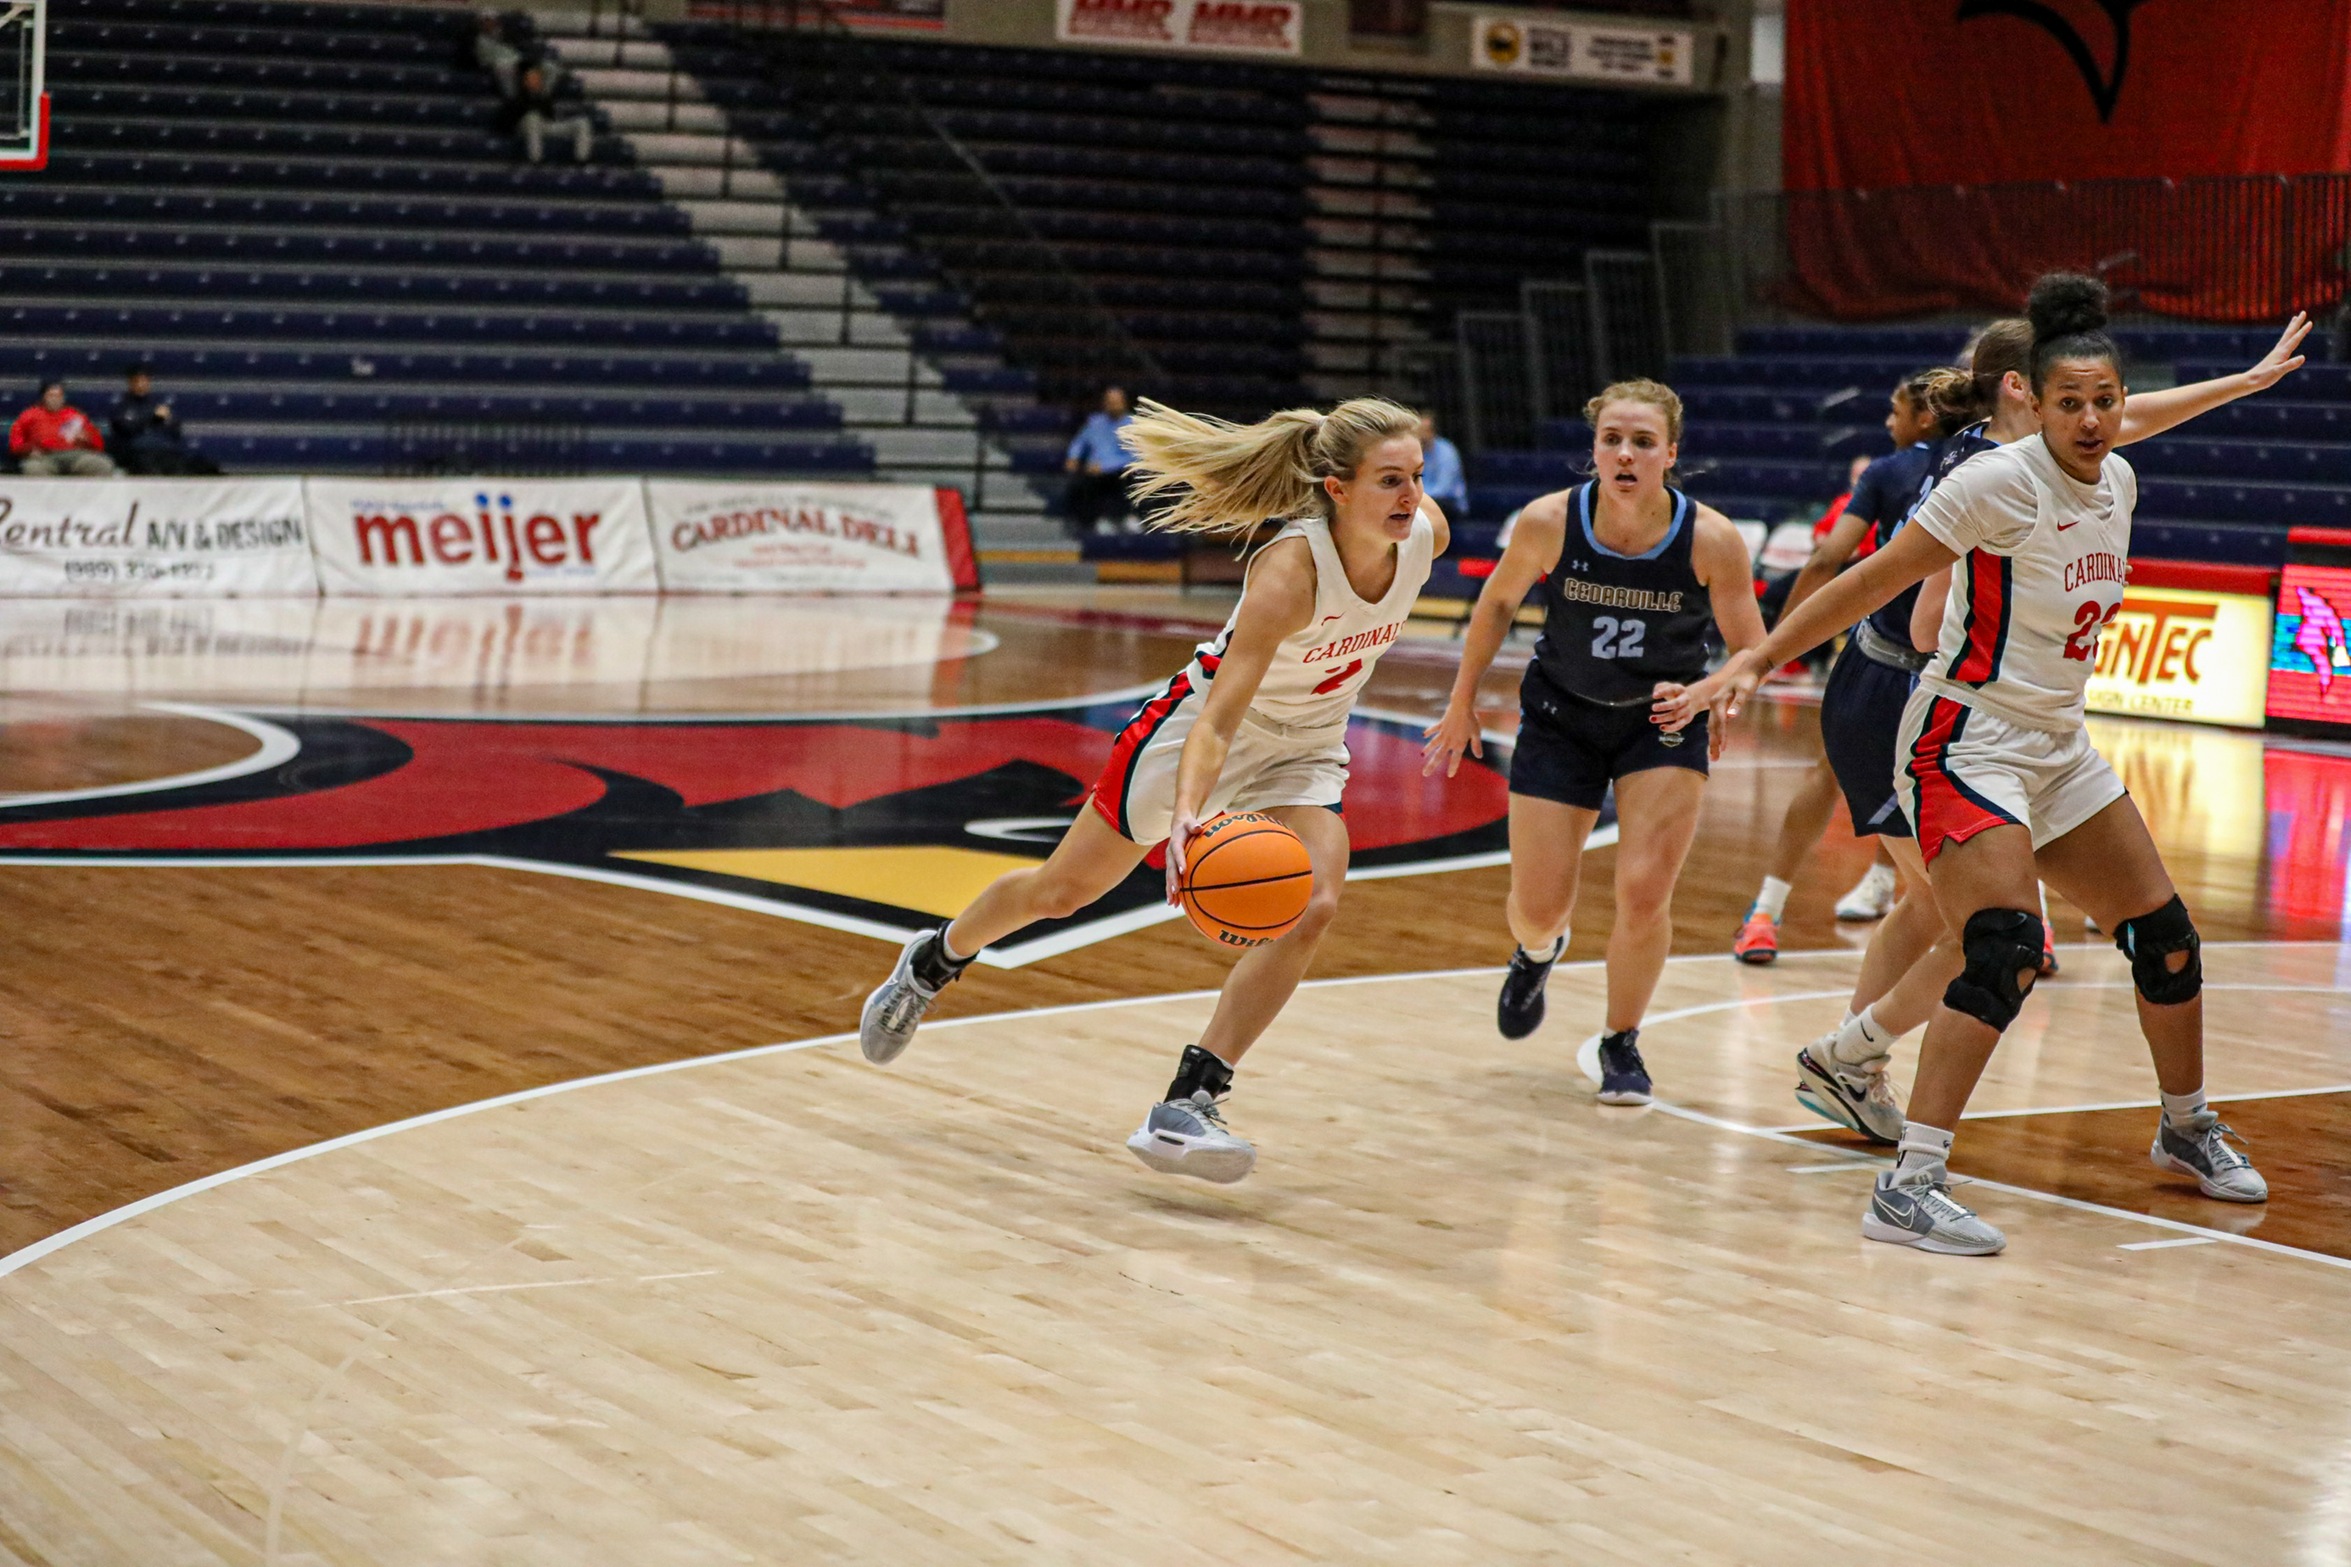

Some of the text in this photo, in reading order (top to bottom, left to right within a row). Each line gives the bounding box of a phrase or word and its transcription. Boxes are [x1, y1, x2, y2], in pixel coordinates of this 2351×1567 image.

[216, 517, 303, 550] DESIGN
[353, 493, 602, 581] meijer
[671, 506, 835, 554] CARDINAL
[1564, 577, 1683, 613] CEDARVILLE
[1591, 615, 1646, 660] 22
